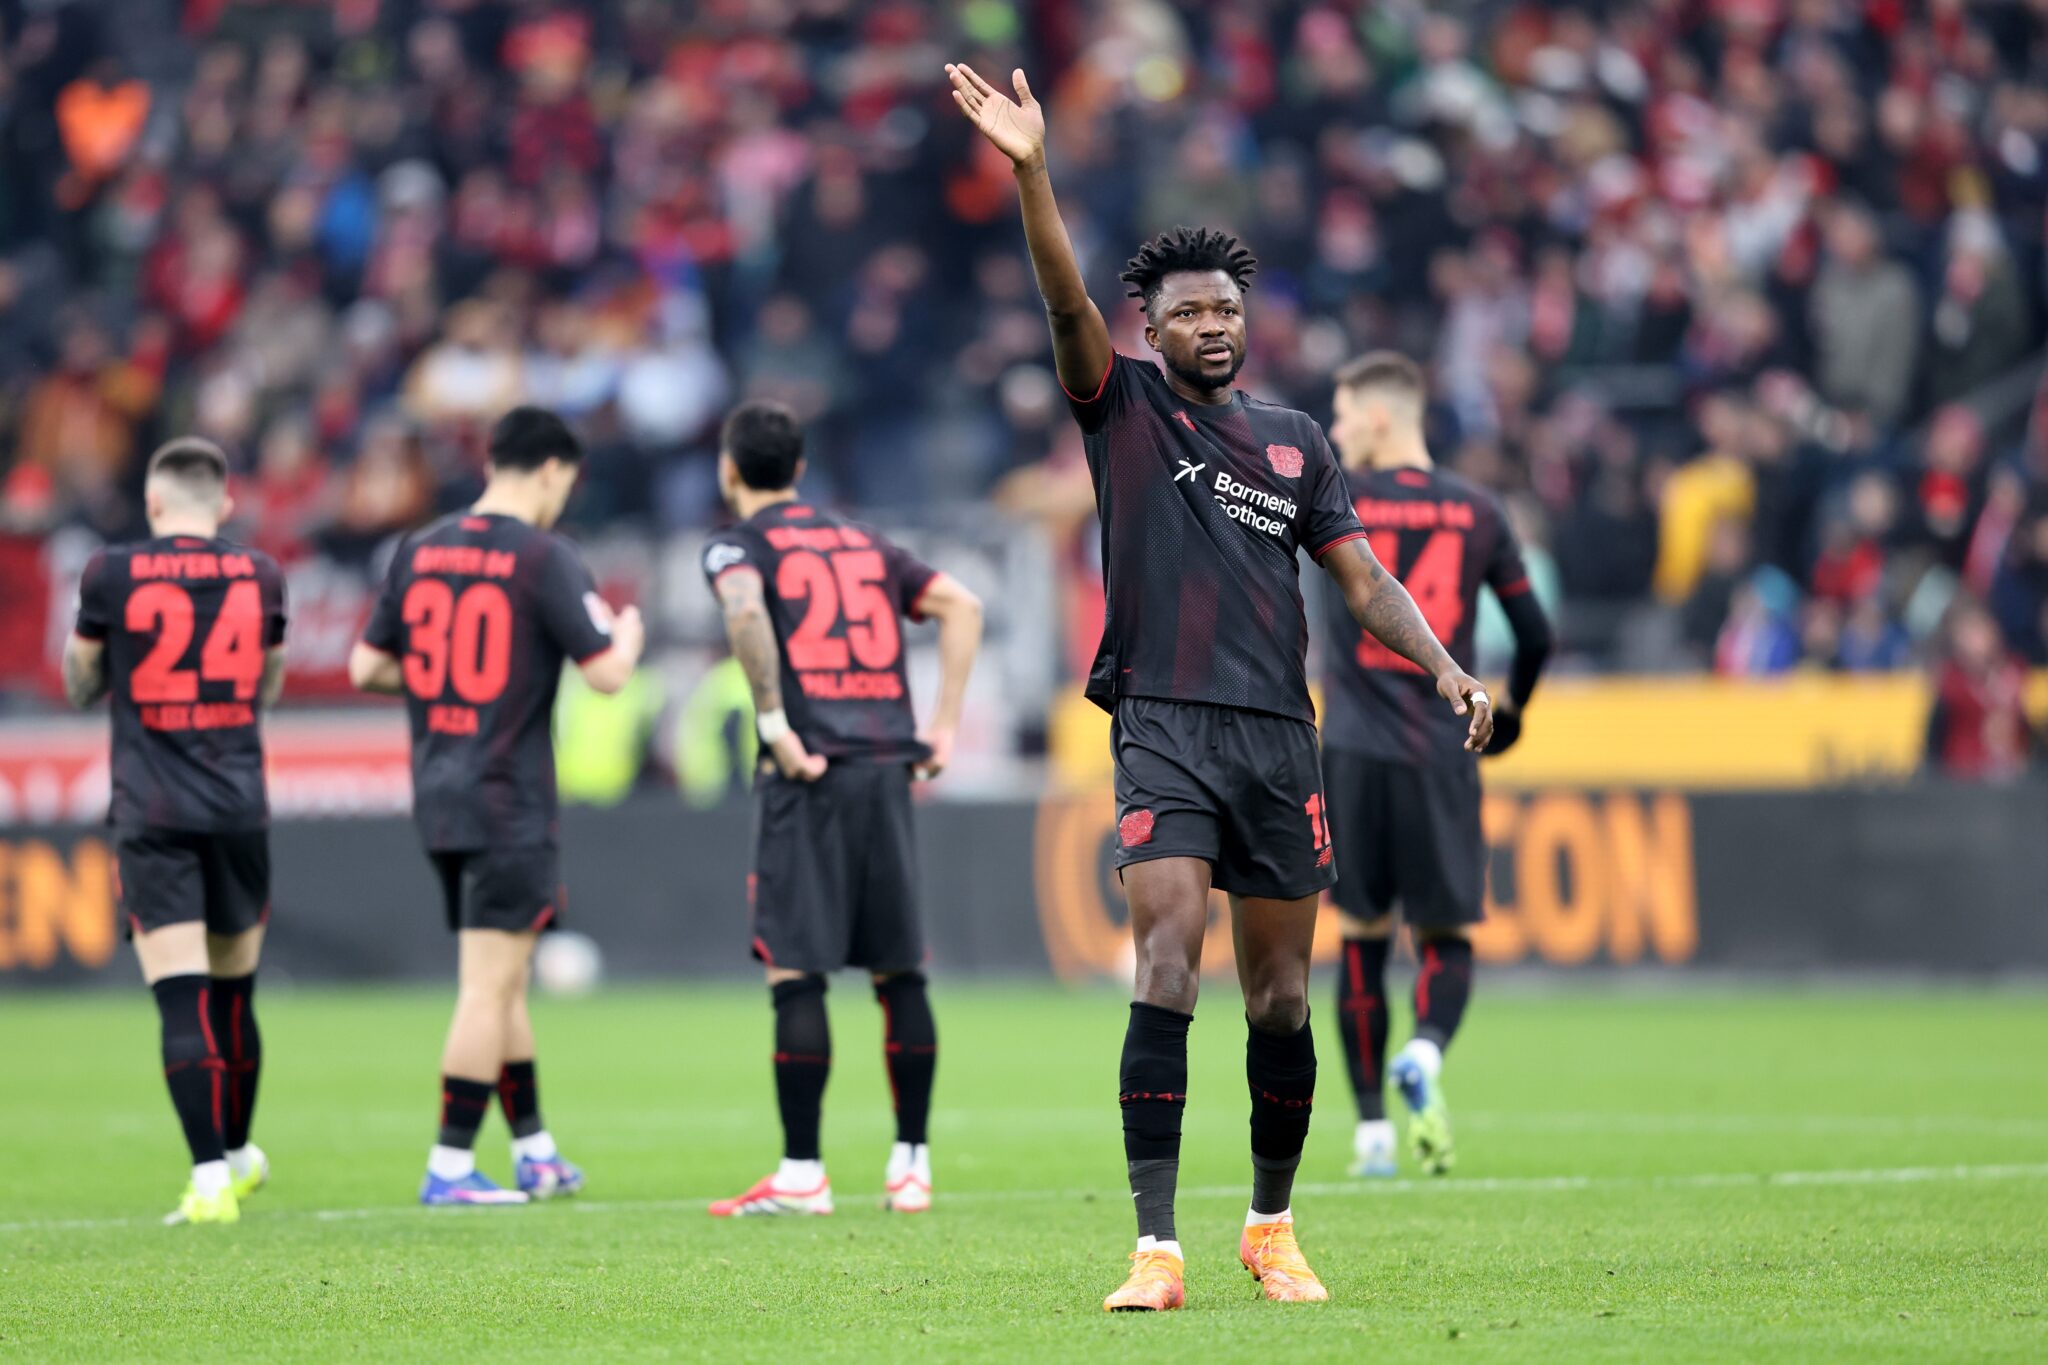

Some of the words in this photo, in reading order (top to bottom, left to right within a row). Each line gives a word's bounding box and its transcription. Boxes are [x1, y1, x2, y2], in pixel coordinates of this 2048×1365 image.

[1214, 472, 1297, 519] Barmenia
[1214, 495, 1287, 537] Gothaer
[131, 553, 219, 580] BAYER
[219, 552, 256, 579] 04
[402, 578, 513, 704] 30
[776, 550, 900, 671] 25
[125, 580, 265, 703] 24
[1305, 789, 1332, 850] 1
